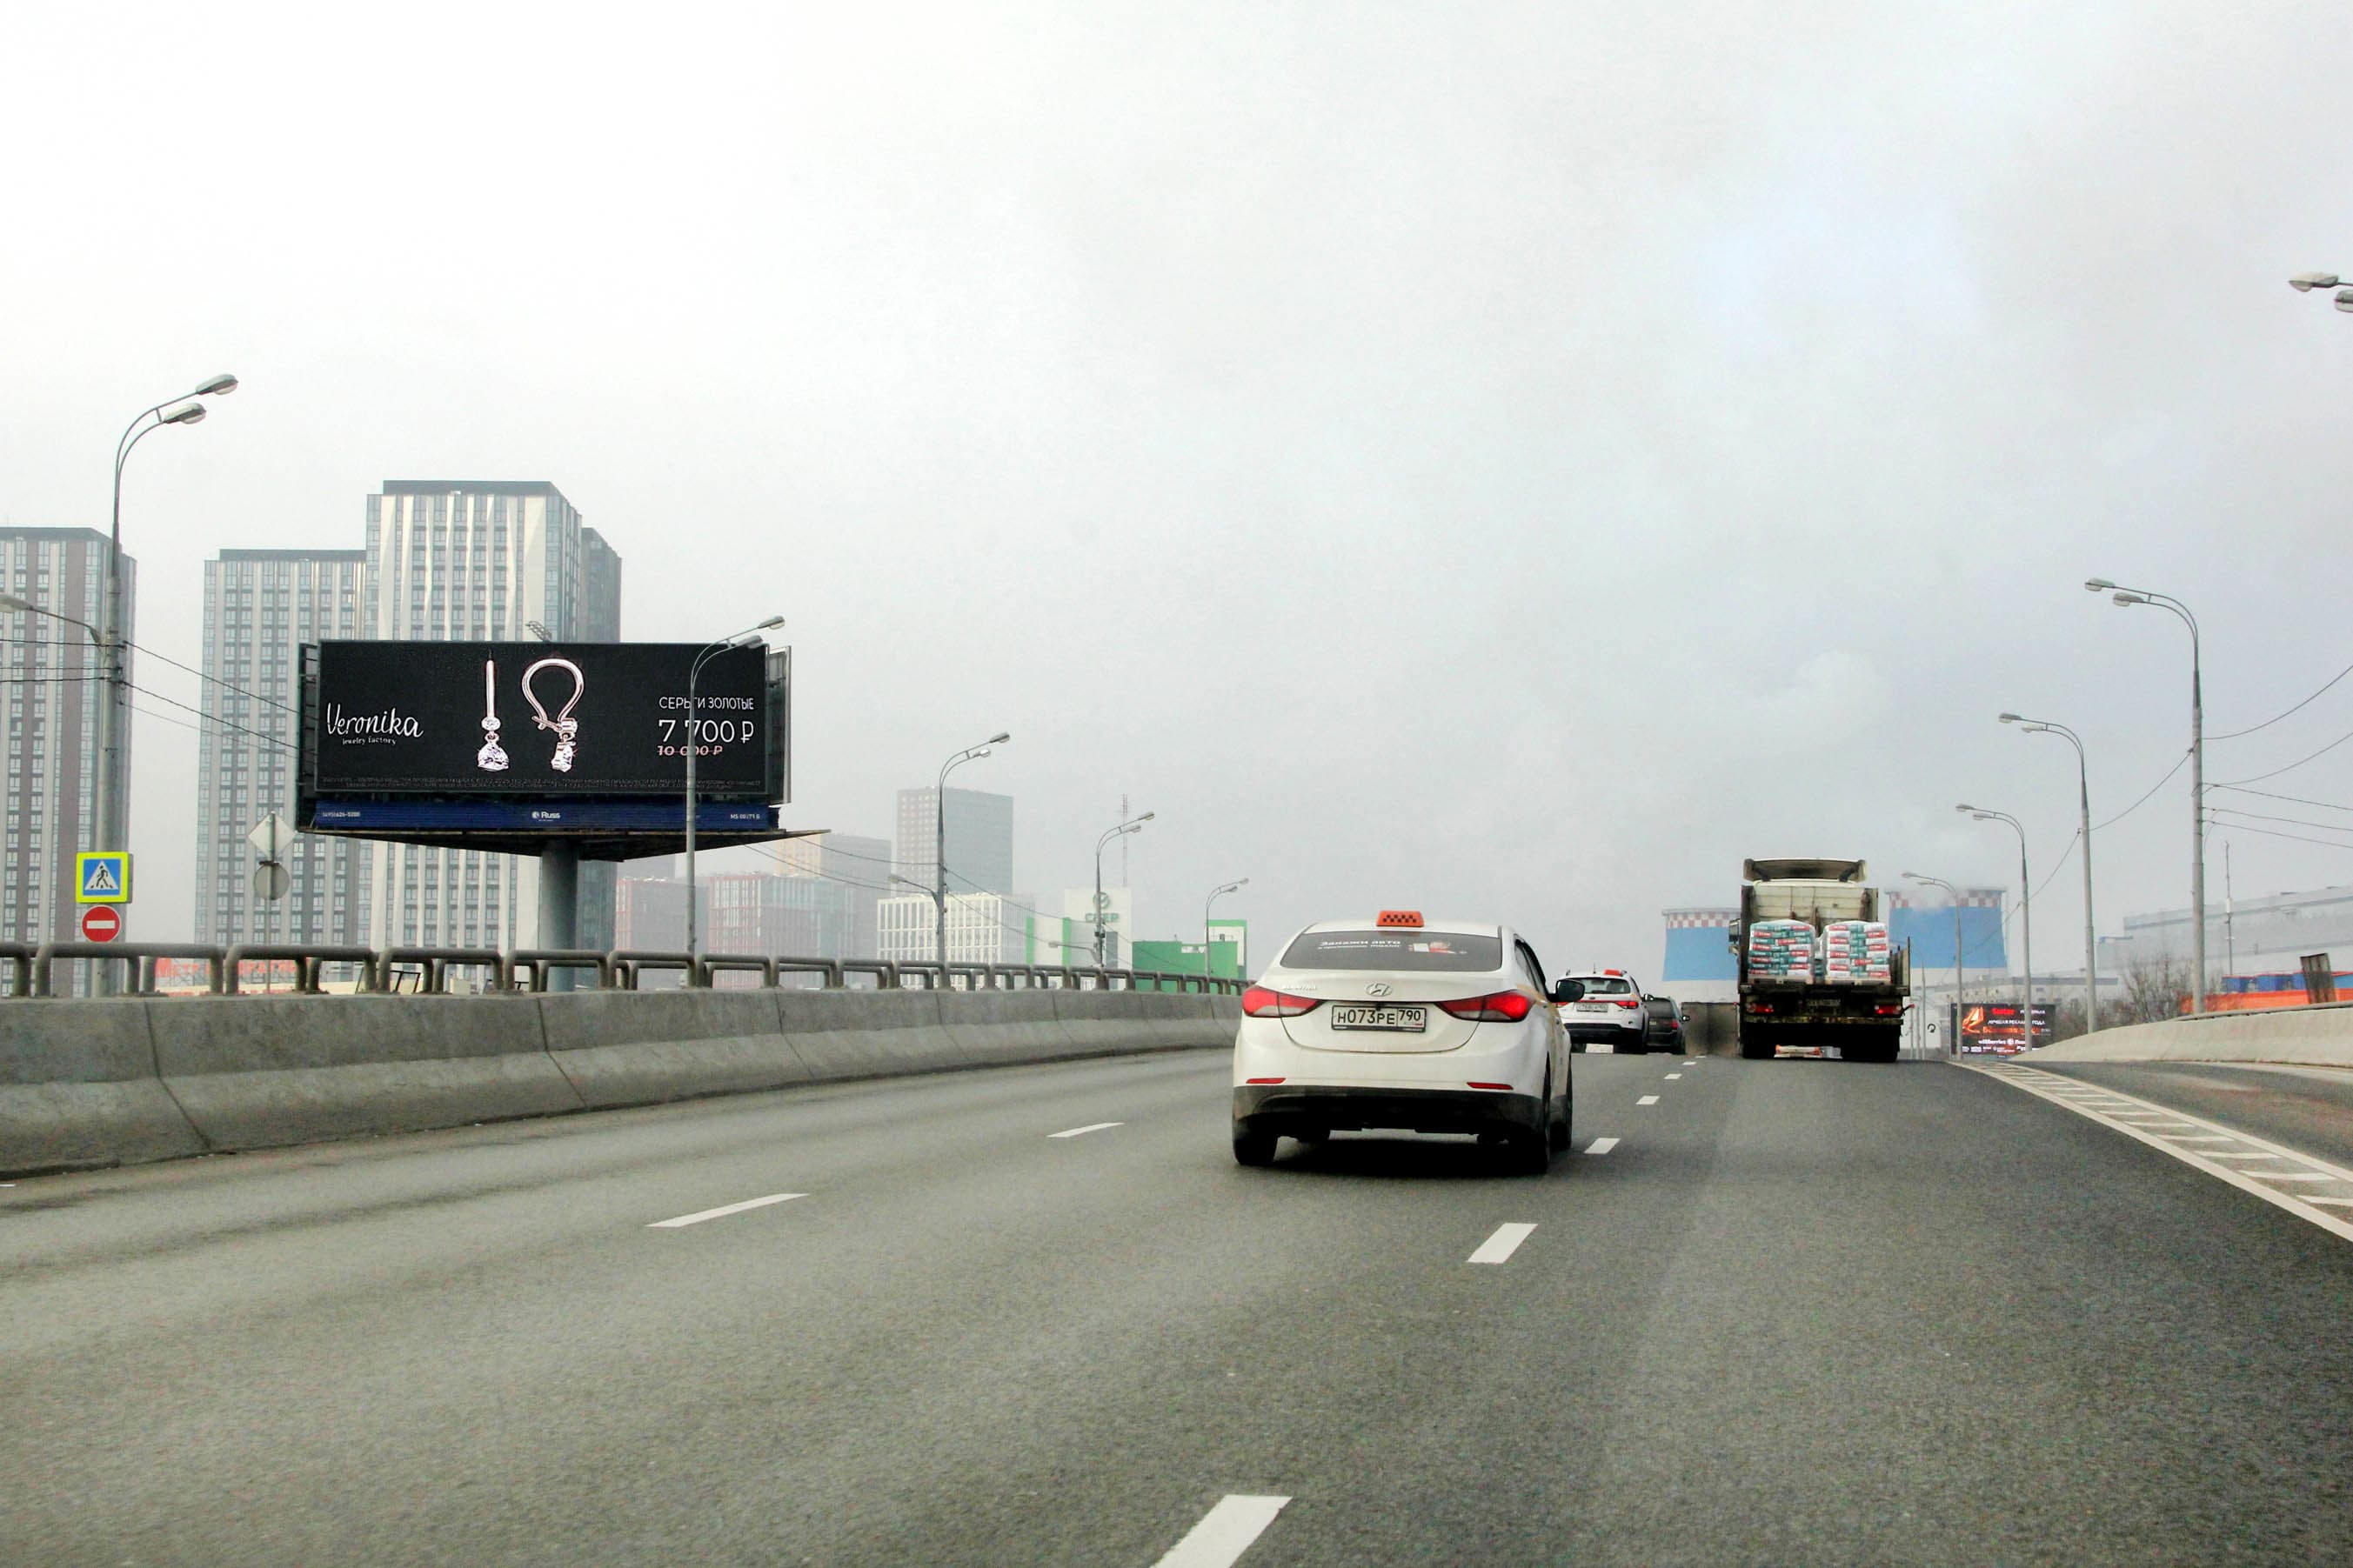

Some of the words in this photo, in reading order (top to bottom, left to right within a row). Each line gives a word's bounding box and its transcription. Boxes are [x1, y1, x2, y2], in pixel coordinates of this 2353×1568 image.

[708, 697, 754, 710] ЗОЛОТЫЕ
[327, 703, 424, 737] Veronika
[658, 719, 676, 742] 7
[685, 719, 735, 743] 700
[368, 736, 397, 745] factory
[657, 745, 675, 756] 10
[541, 811, 560, 819] Russ
[1337, 1009, 1395, 1024] Н073РЕ
[1398, 1010, 1421, 1022] 790
